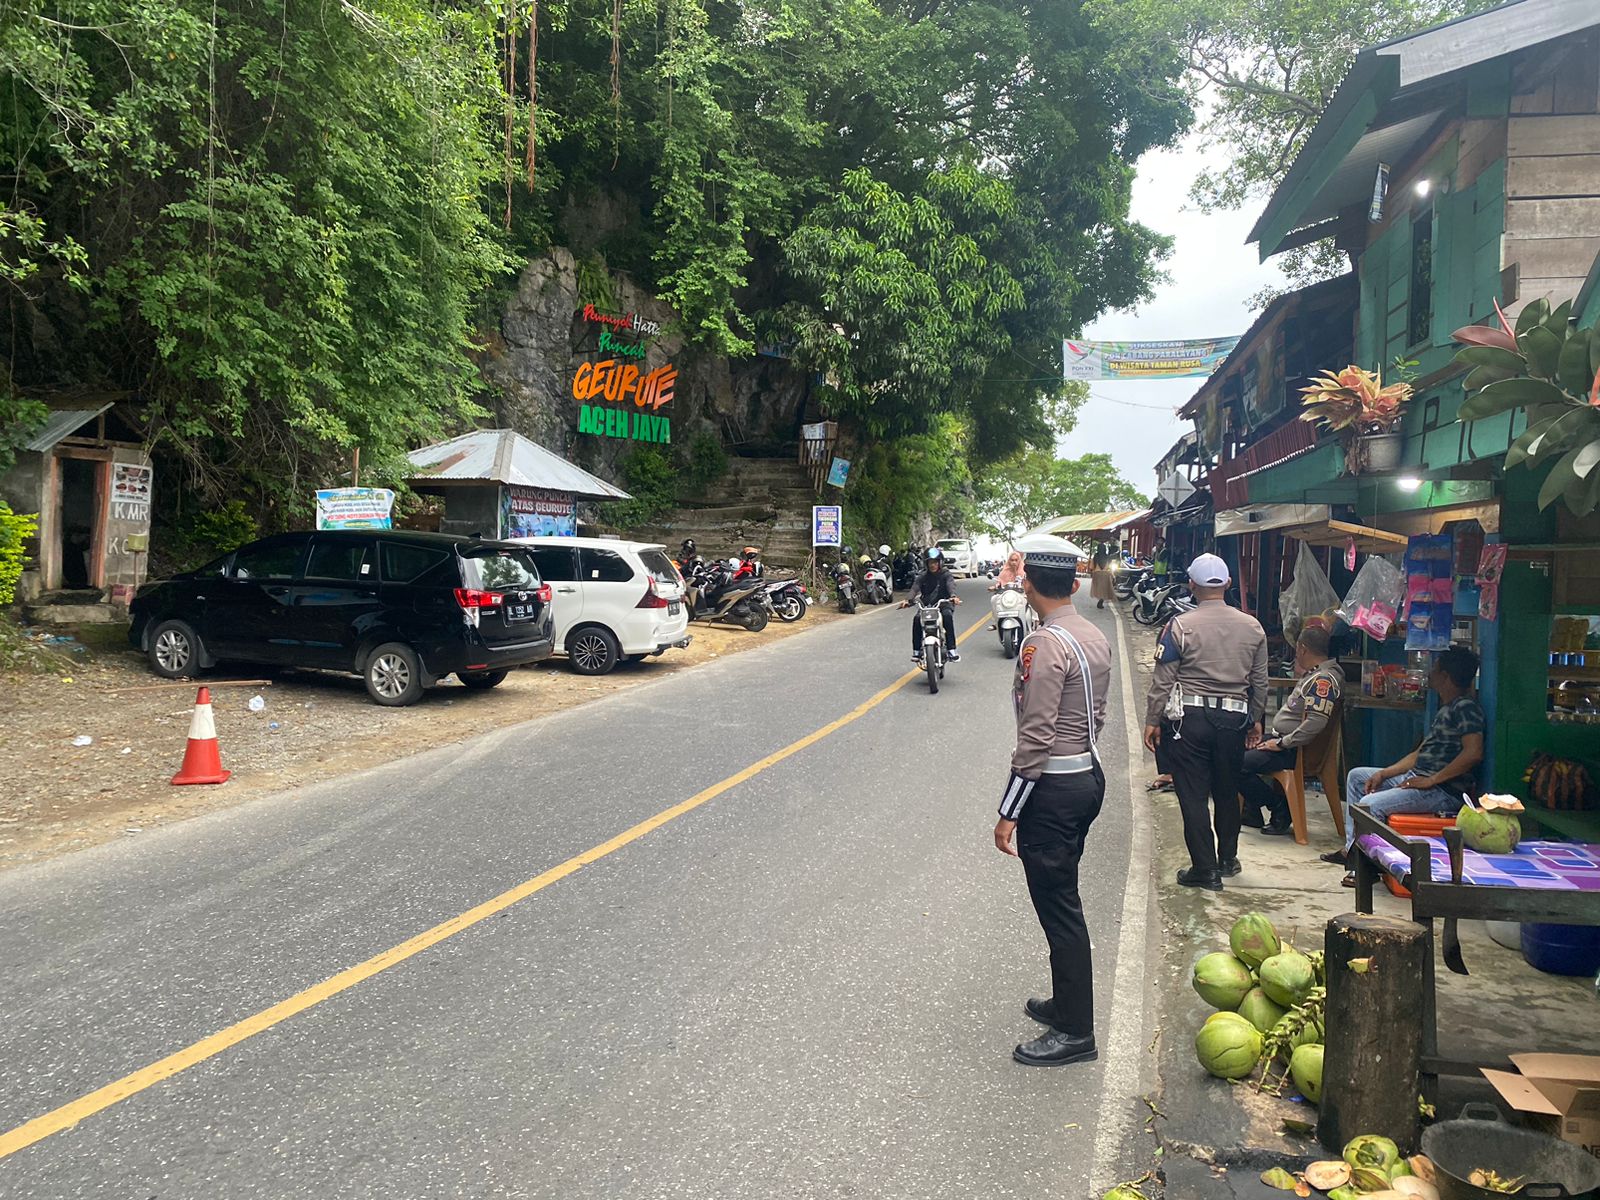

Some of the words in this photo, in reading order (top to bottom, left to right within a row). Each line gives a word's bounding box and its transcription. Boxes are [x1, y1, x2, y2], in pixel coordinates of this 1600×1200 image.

[599, 332, 647, 359] Puncak
[1123, 350, 1154, 360] CABANG
[1109, 360, 1119, 370] DI
[1120, 360, 1149, 370] WISATA
[1151, 360, 1179, 369] TAMAN
[1180, 359, 1201, 369] RUSA
[572, 360, 678, 410] GEURUTE
[578, 404, 629, 439] ACEH
[632, 412, 671, 443] JAYA
[509, 487, 542, 500] WARUNG
[115, 502, 149, 521] KMR
[511, 499, 534, 511] ATAS
[535, 502, 571, 514] GEURUTE
[1305, 696, 1335, 716] PJR
